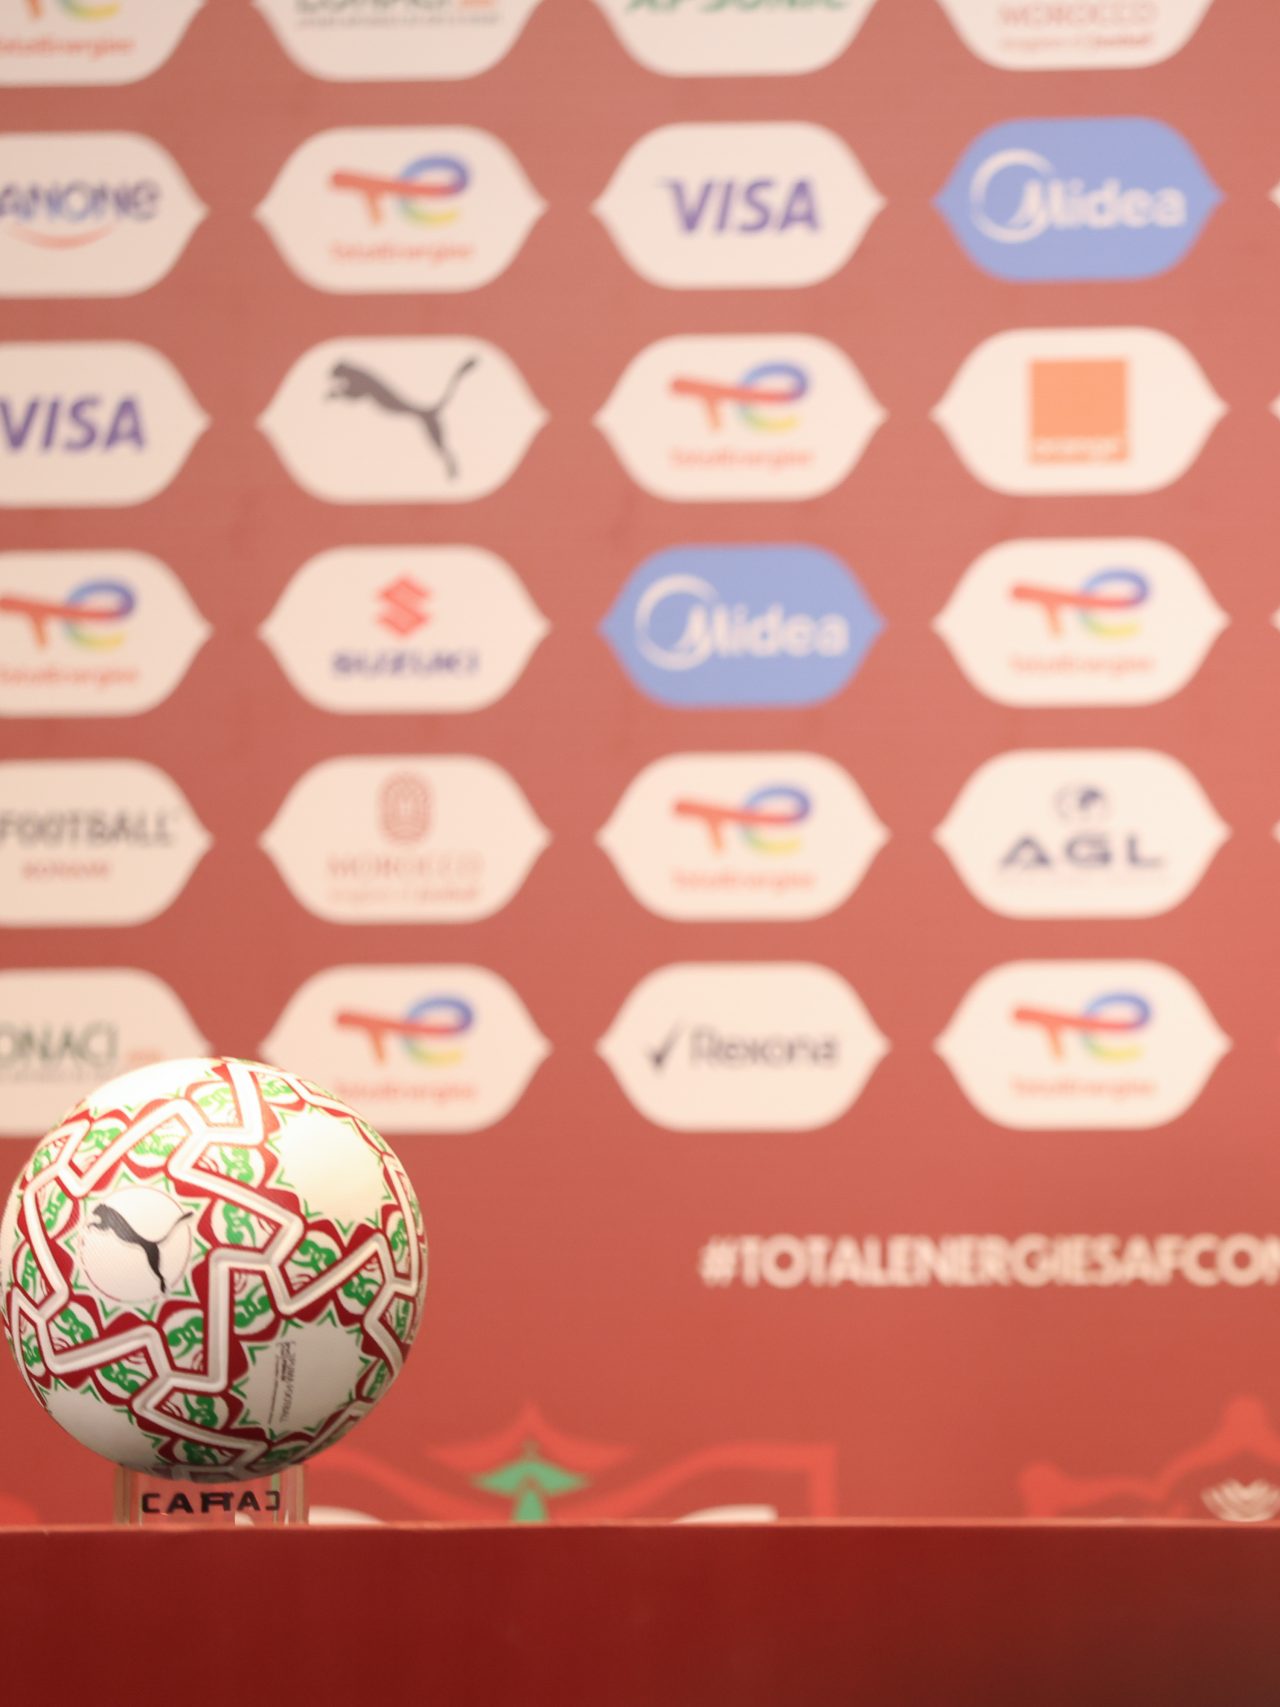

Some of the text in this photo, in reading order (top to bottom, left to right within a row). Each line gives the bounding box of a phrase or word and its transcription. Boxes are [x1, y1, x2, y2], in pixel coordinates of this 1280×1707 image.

[665, 178, 820, 234] VISA
[0, 395, 145, 452] VISA
[1002, 835, 1155, 868] AGL
